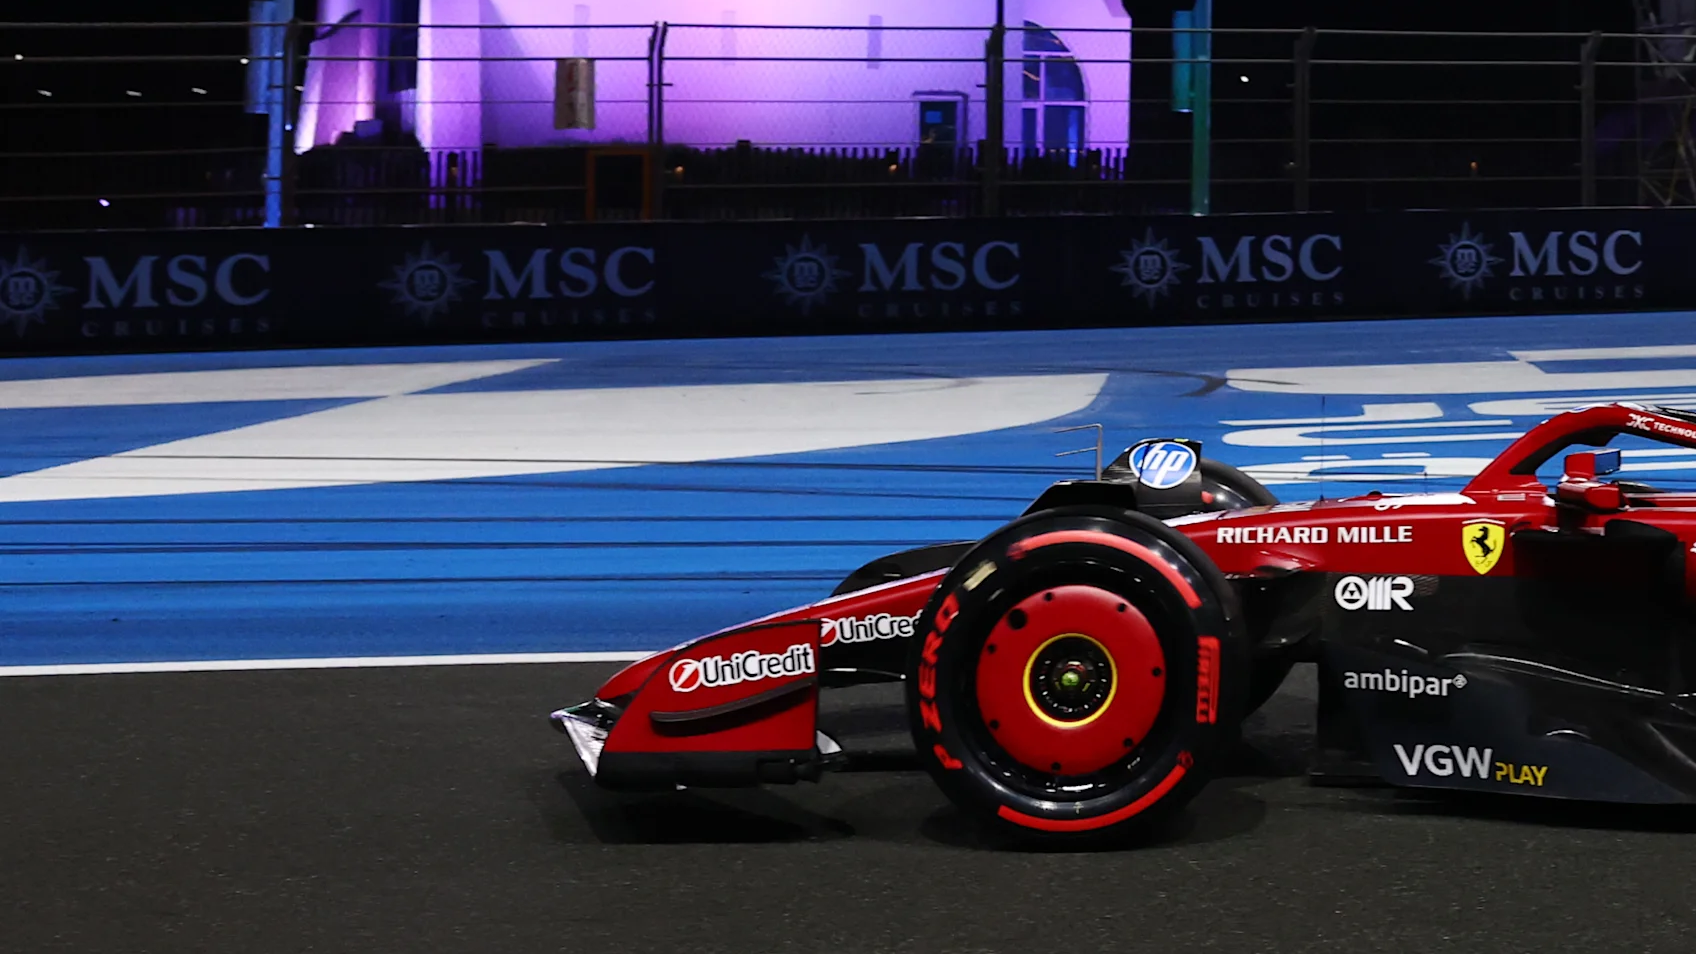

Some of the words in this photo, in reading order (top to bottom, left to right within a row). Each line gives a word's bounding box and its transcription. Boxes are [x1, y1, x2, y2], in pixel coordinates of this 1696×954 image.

[483, 246, 656, 300] MSC
[857, 240, 1021, 292] MSC
[1196, 233, 1342, 283] MSC
[1509, 229, 1643, 277] MSC
[82, 253, 271, 308] MSC
[1196, 290, 1344, 308] CRUISES
[1509, 284, 1644, 301] CRUISES
[1137, 443, 1193, 488] hp
[1216, 525, 1329, 544] RICHARD
[1336, 525, 1413, 543] MILLE
[700, 645, 815, 688] UniCredit
[1344, 669, 1455, 698] ambipar
[1393, 744, 1493, 780] VGW
[1495, 761, 1548, 787] PLAY
